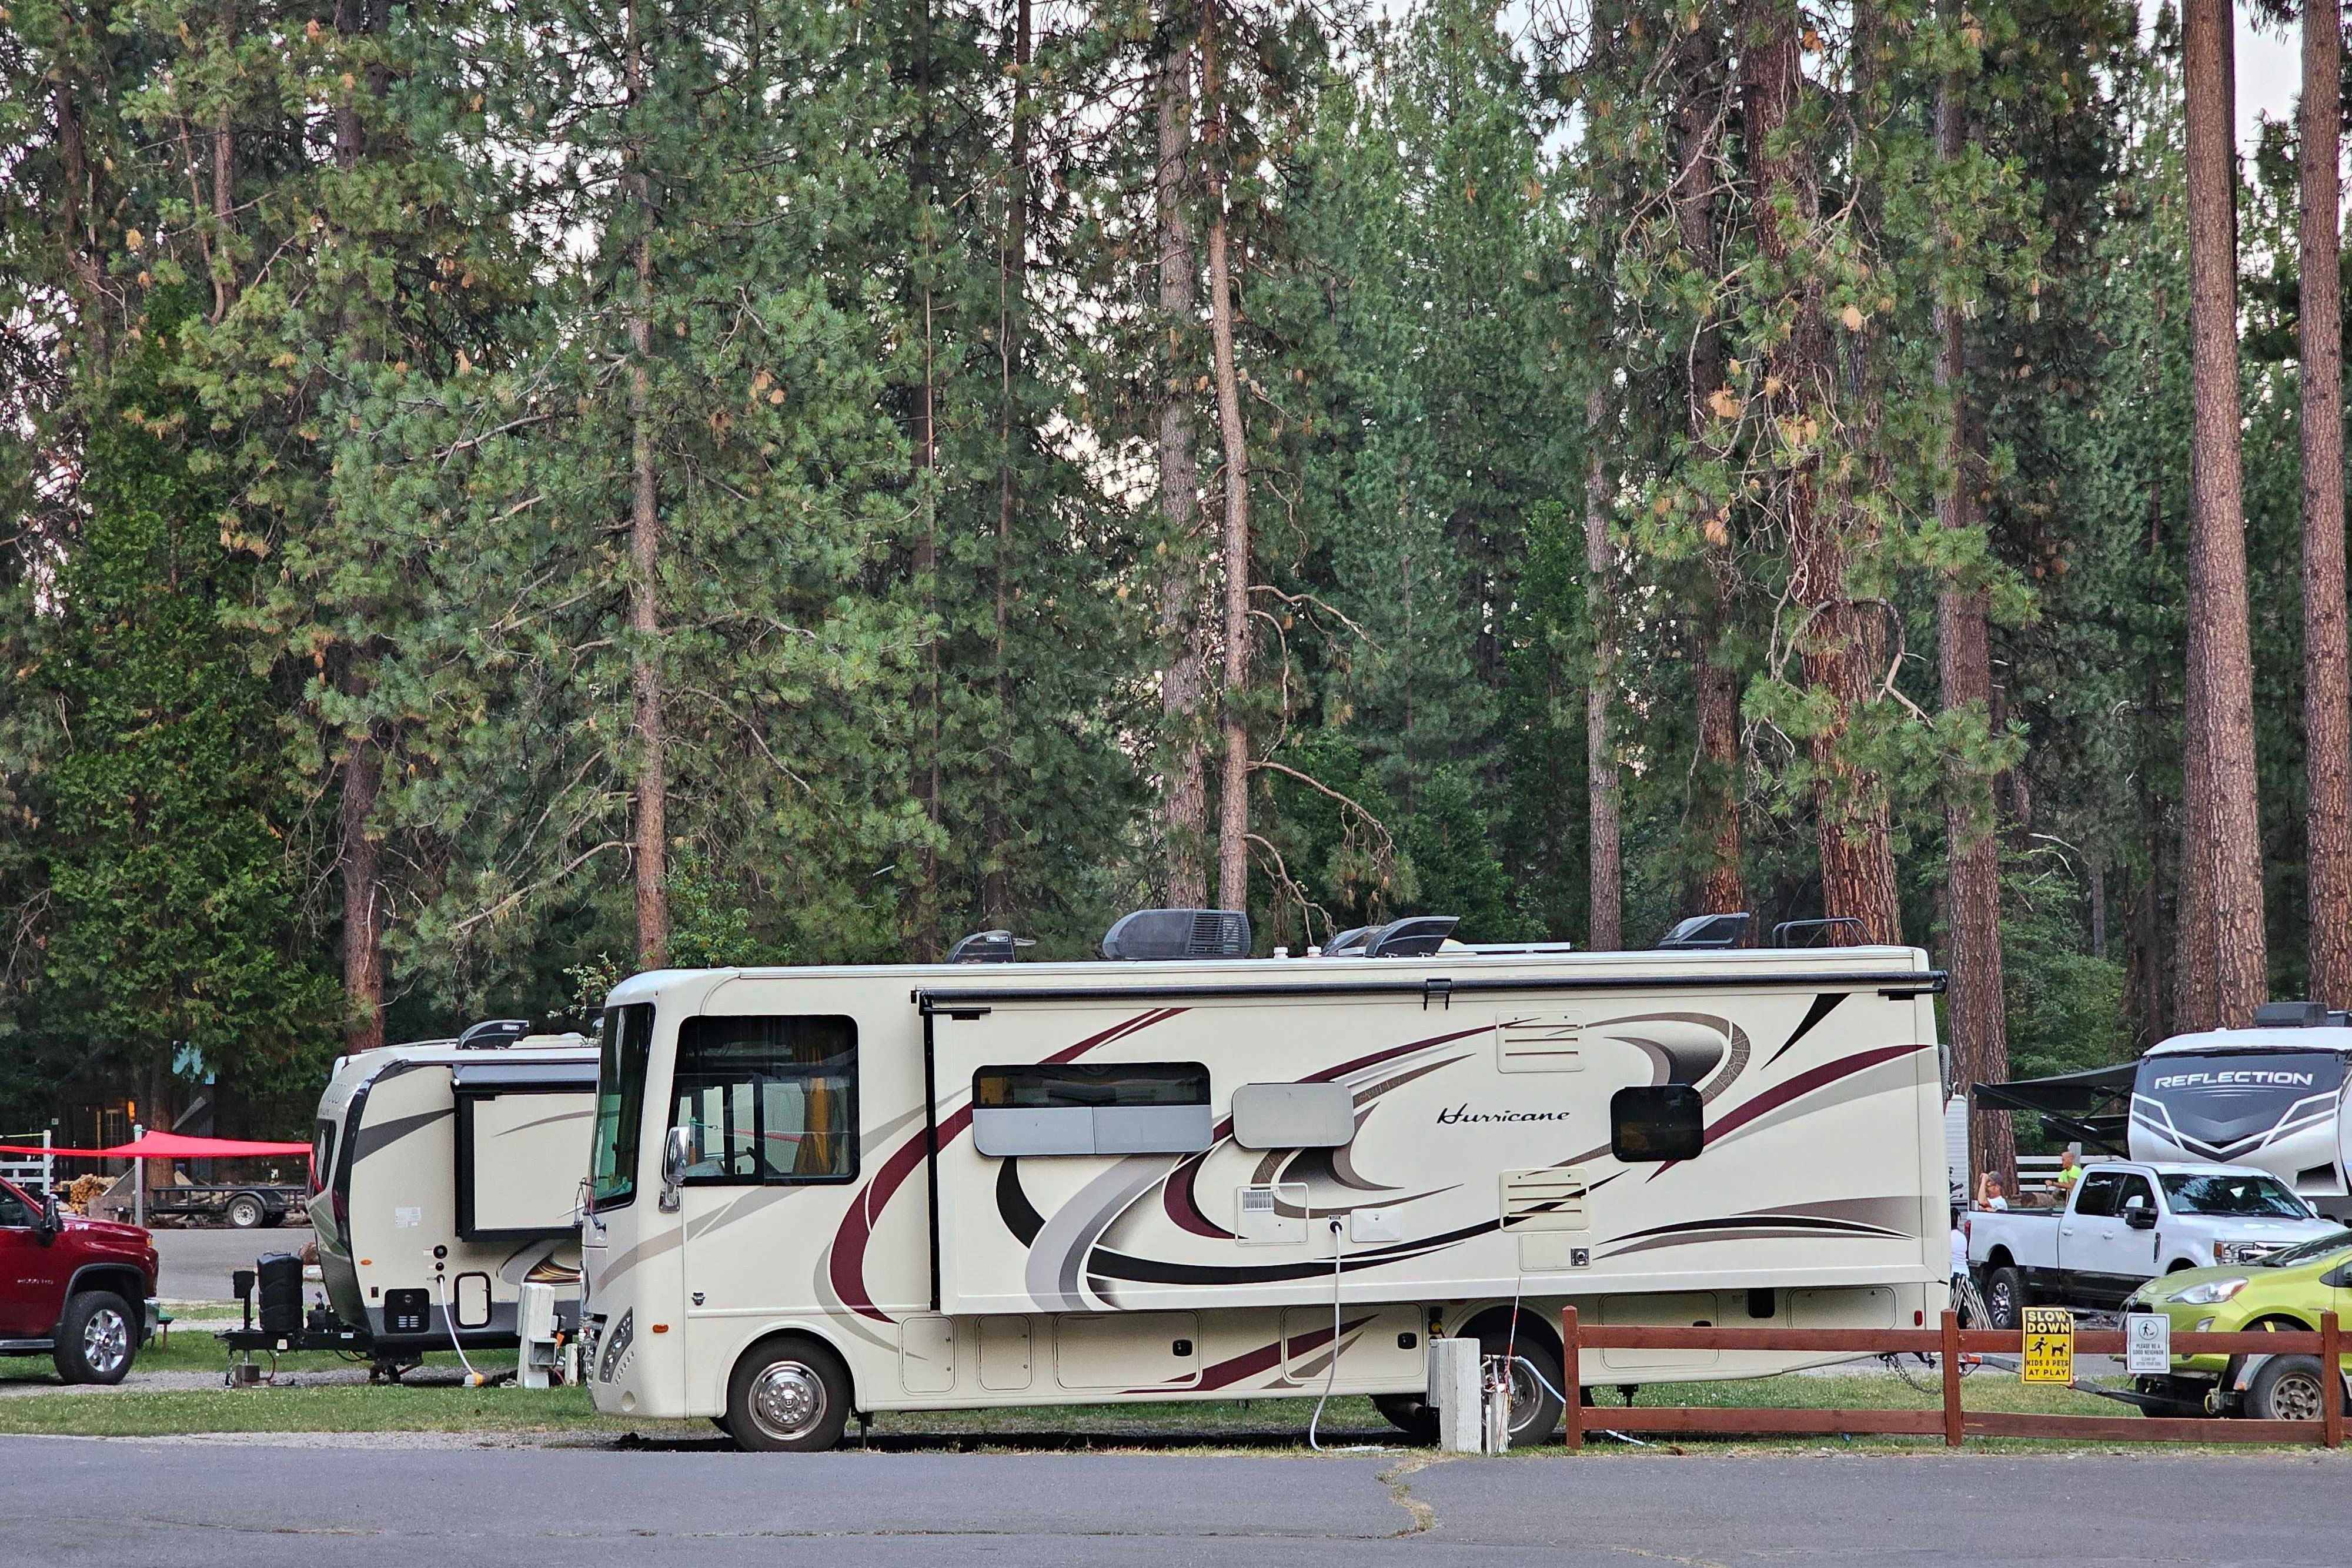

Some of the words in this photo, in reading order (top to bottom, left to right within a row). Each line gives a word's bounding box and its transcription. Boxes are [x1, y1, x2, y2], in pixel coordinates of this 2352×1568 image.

[2154, 1071, 2313, 1089] REFLECTION
[1436, 1103, 1571, 1124] Hurricane
[2027, 1311, 2066, 1322] SLOW
[2027, 1322, 2069, 1333] DOWN
